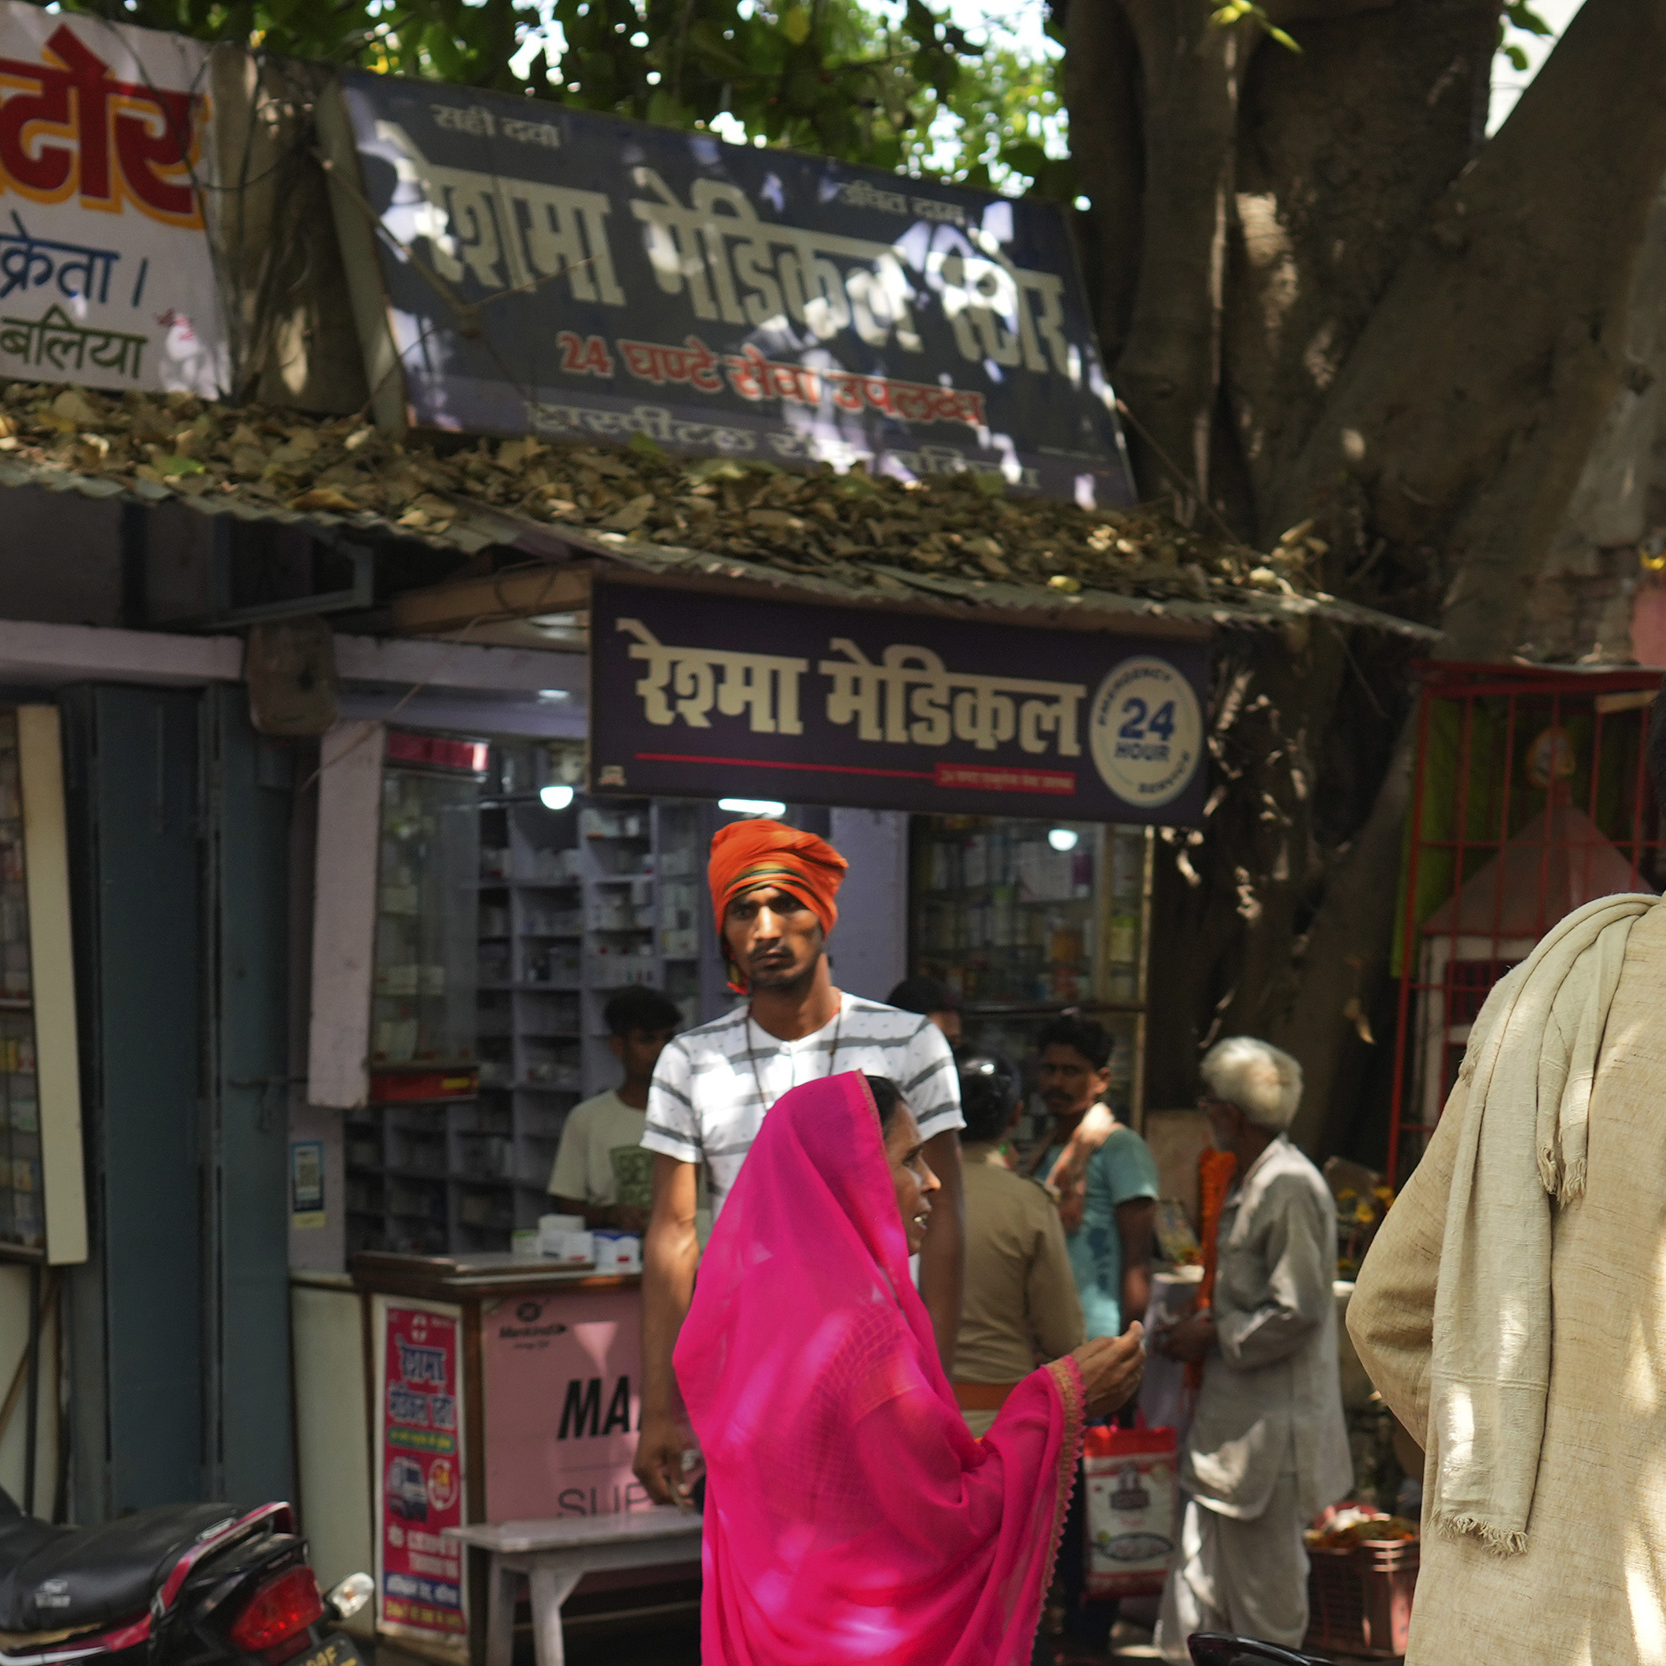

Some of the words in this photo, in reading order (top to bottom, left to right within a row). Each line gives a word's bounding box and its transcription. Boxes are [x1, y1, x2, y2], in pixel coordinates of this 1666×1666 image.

[0, 304, 148, 379] बलिया
[557, 333, 613, 378] 24
[819, 637, 1088, 757] मेडिकल
[1119, 696, 1175, 742] 24
[1115, 742, 1170, 762] HOUR
[557, 1374, 641, 1441] MA
